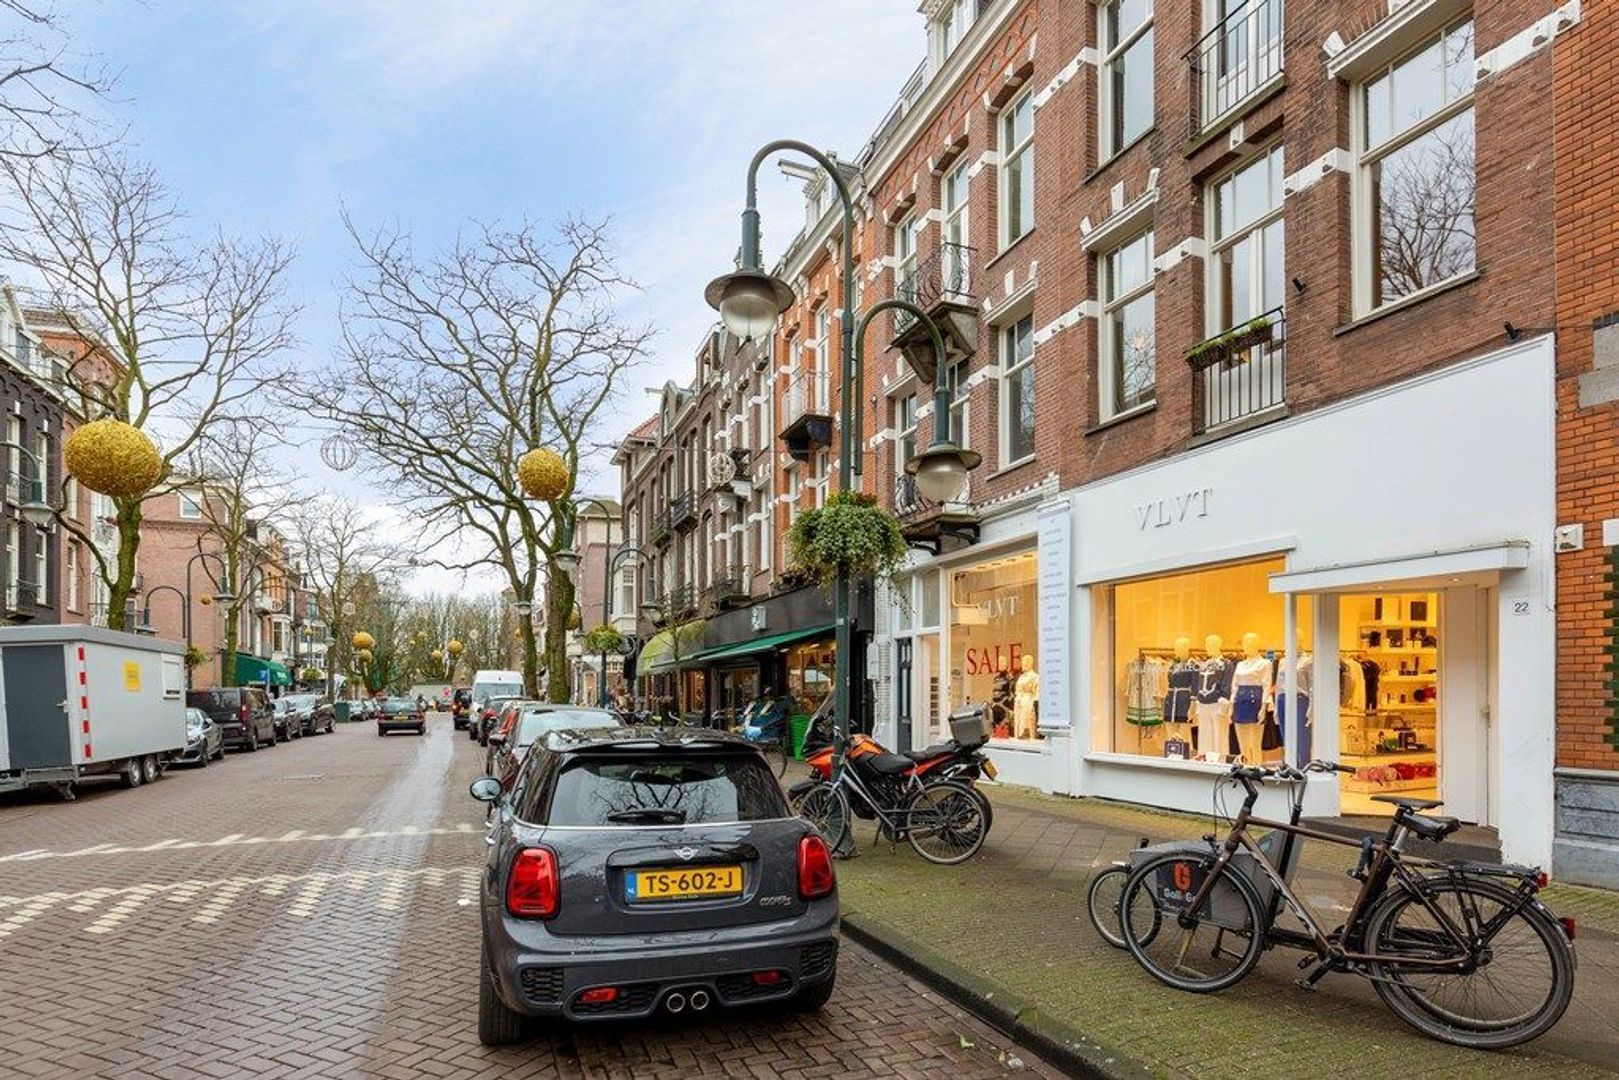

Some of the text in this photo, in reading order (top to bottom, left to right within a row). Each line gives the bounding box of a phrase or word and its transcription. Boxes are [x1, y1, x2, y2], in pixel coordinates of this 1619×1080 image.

[1136, 487, 1213, 531] VLVT
[1514, 602, 1530, 614] 22
[967, 642, 1023, 675] SALE
[645, 871, 733, 893] TS-602-J
